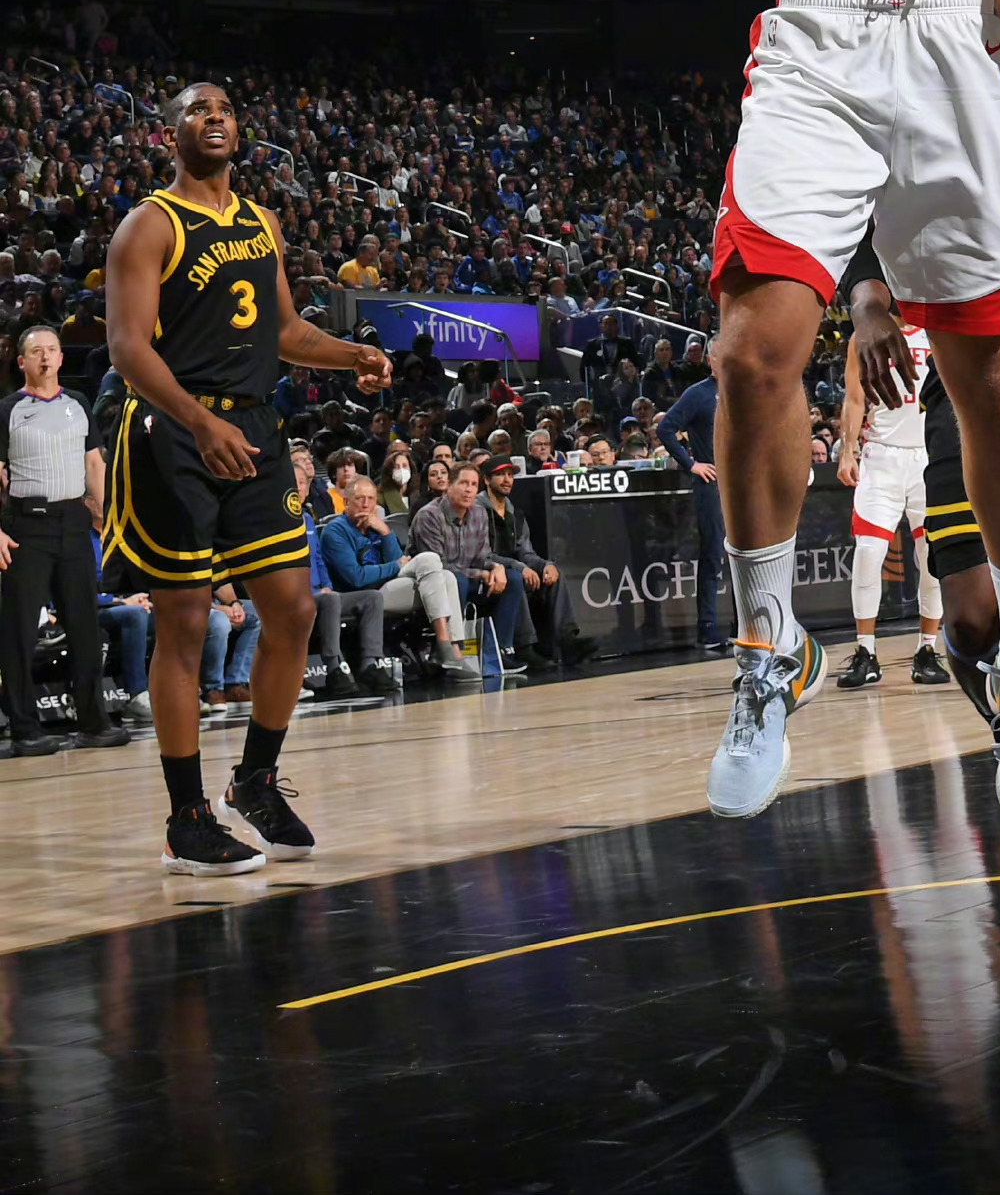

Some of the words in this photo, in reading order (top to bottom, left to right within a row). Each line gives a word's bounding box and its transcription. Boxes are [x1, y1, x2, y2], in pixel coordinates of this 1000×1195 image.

[188, 252, 219, 292] SAN
[209, 232, 273, 264] FRANCISCO
[229, 279, 258, 329] 3
[413, 313, 491, 351] xfinity
[553, 473, 612, 494] CHASE
[793, 546, 853, 587] EEK
